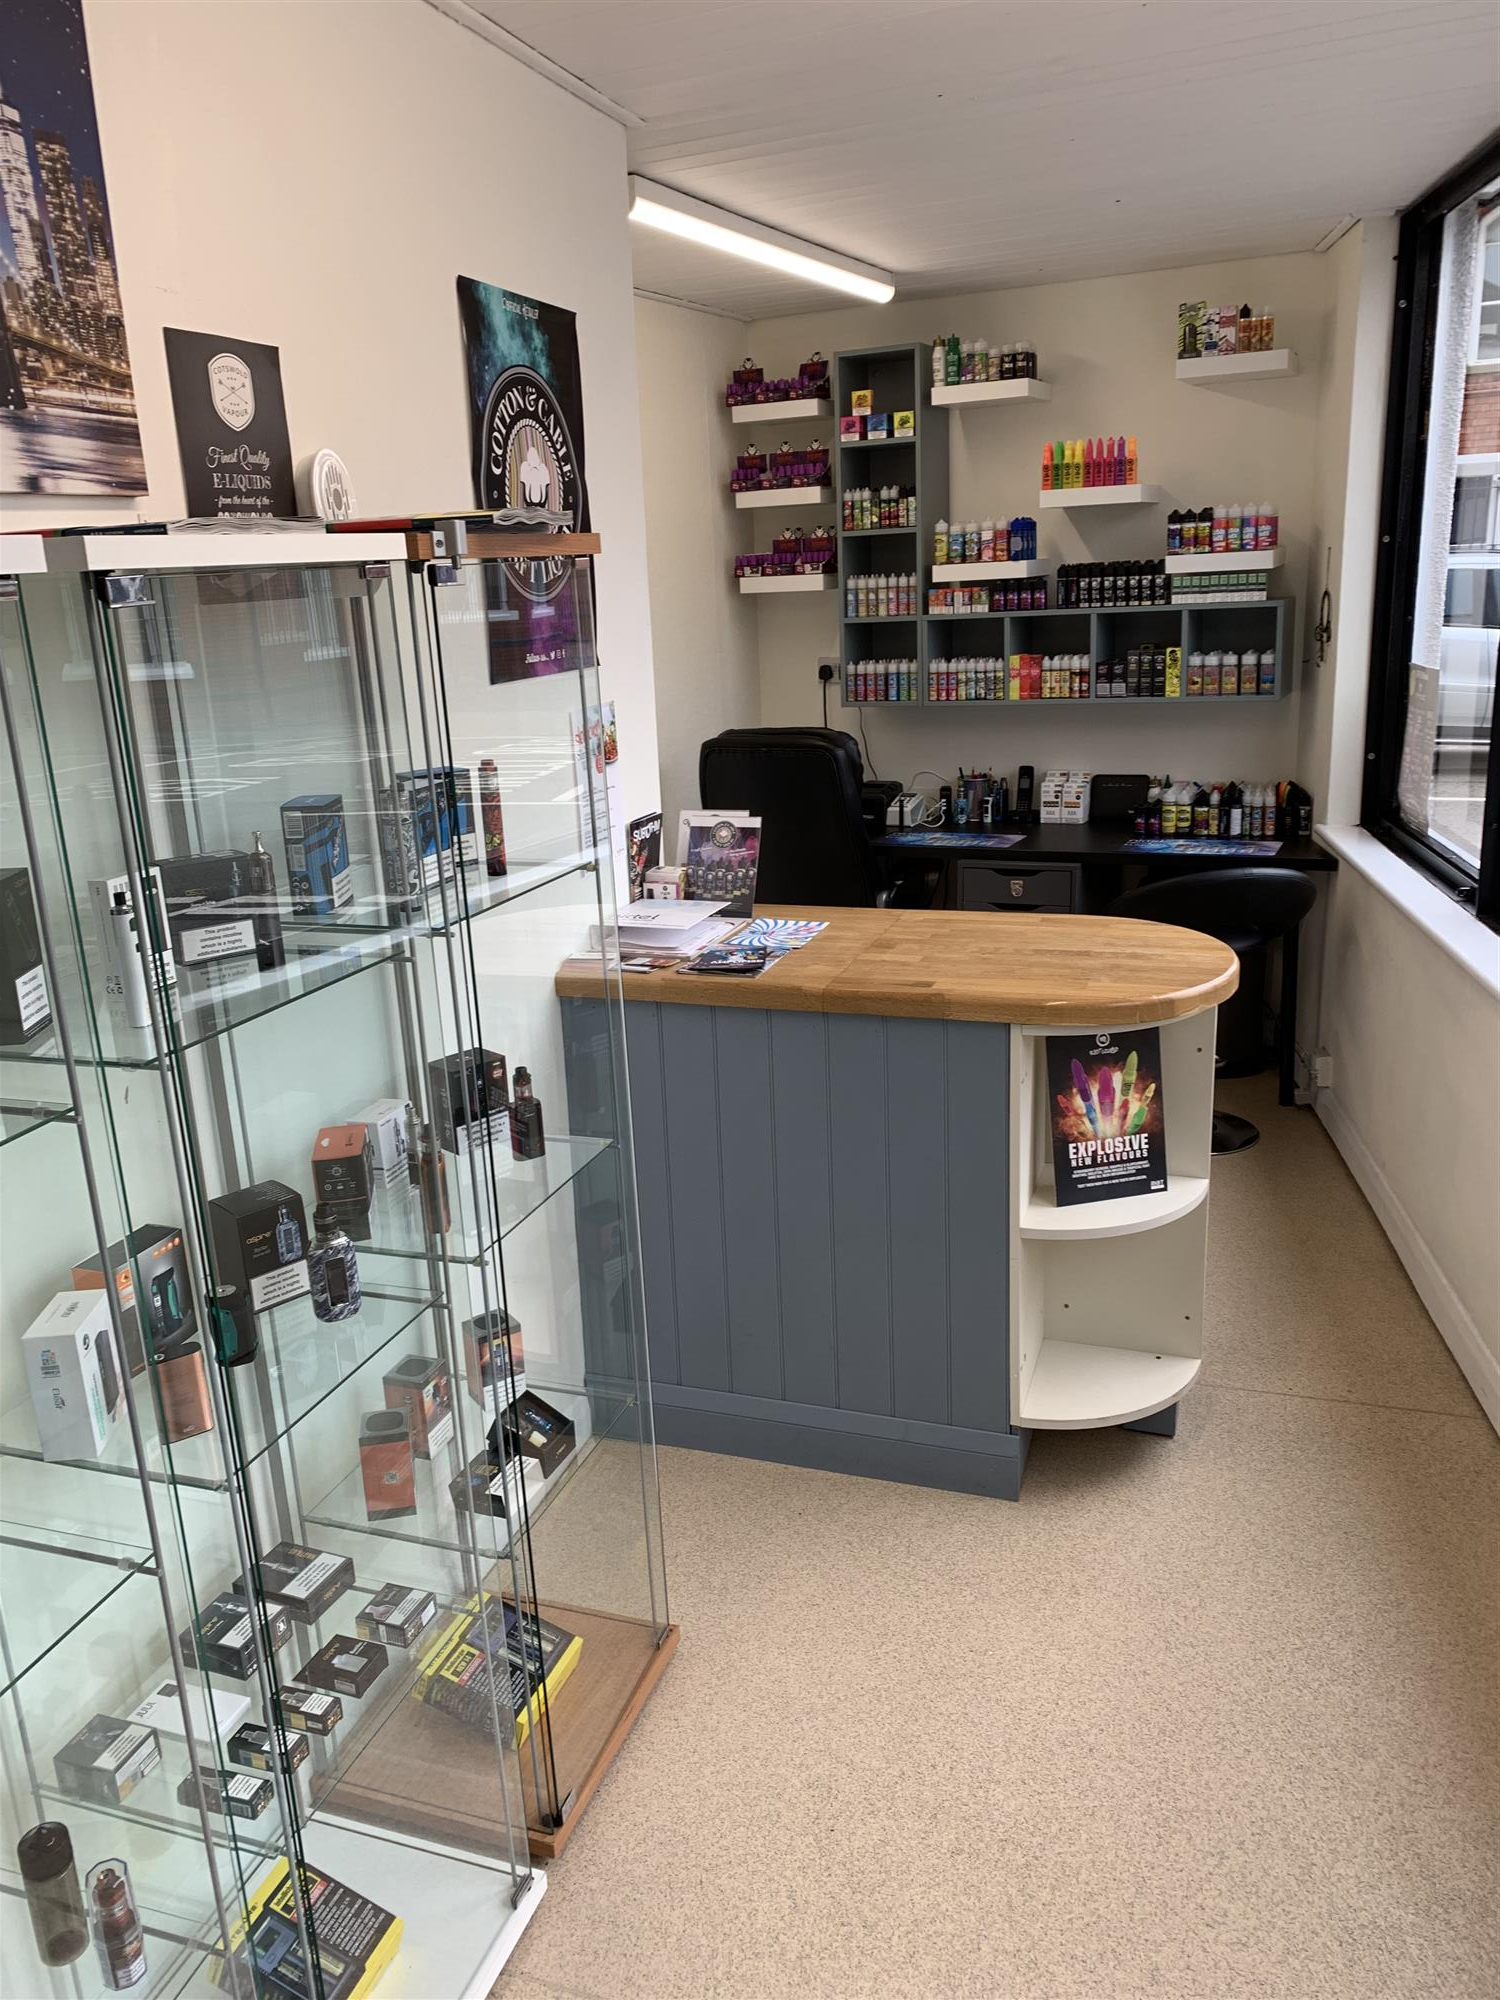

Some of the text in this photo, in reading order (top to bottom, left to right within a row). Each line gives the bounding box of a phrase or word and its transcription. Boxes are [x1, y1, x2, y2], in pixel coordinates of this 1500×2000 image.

[213, 365, 248, 379] COTSWOLD
[221, 405, 249, 417] VAPOUR
[490, 385, 574, 481] COTTON & CABLE
[239, 444, 271, 471] Quality
[212, 472, 272, 492] E-LIQUIDS
[1068, 1133, 1149, 1159] EXPLOSIVE
[1071, 1148, 1149, 1167] NEW FLAVOURS
